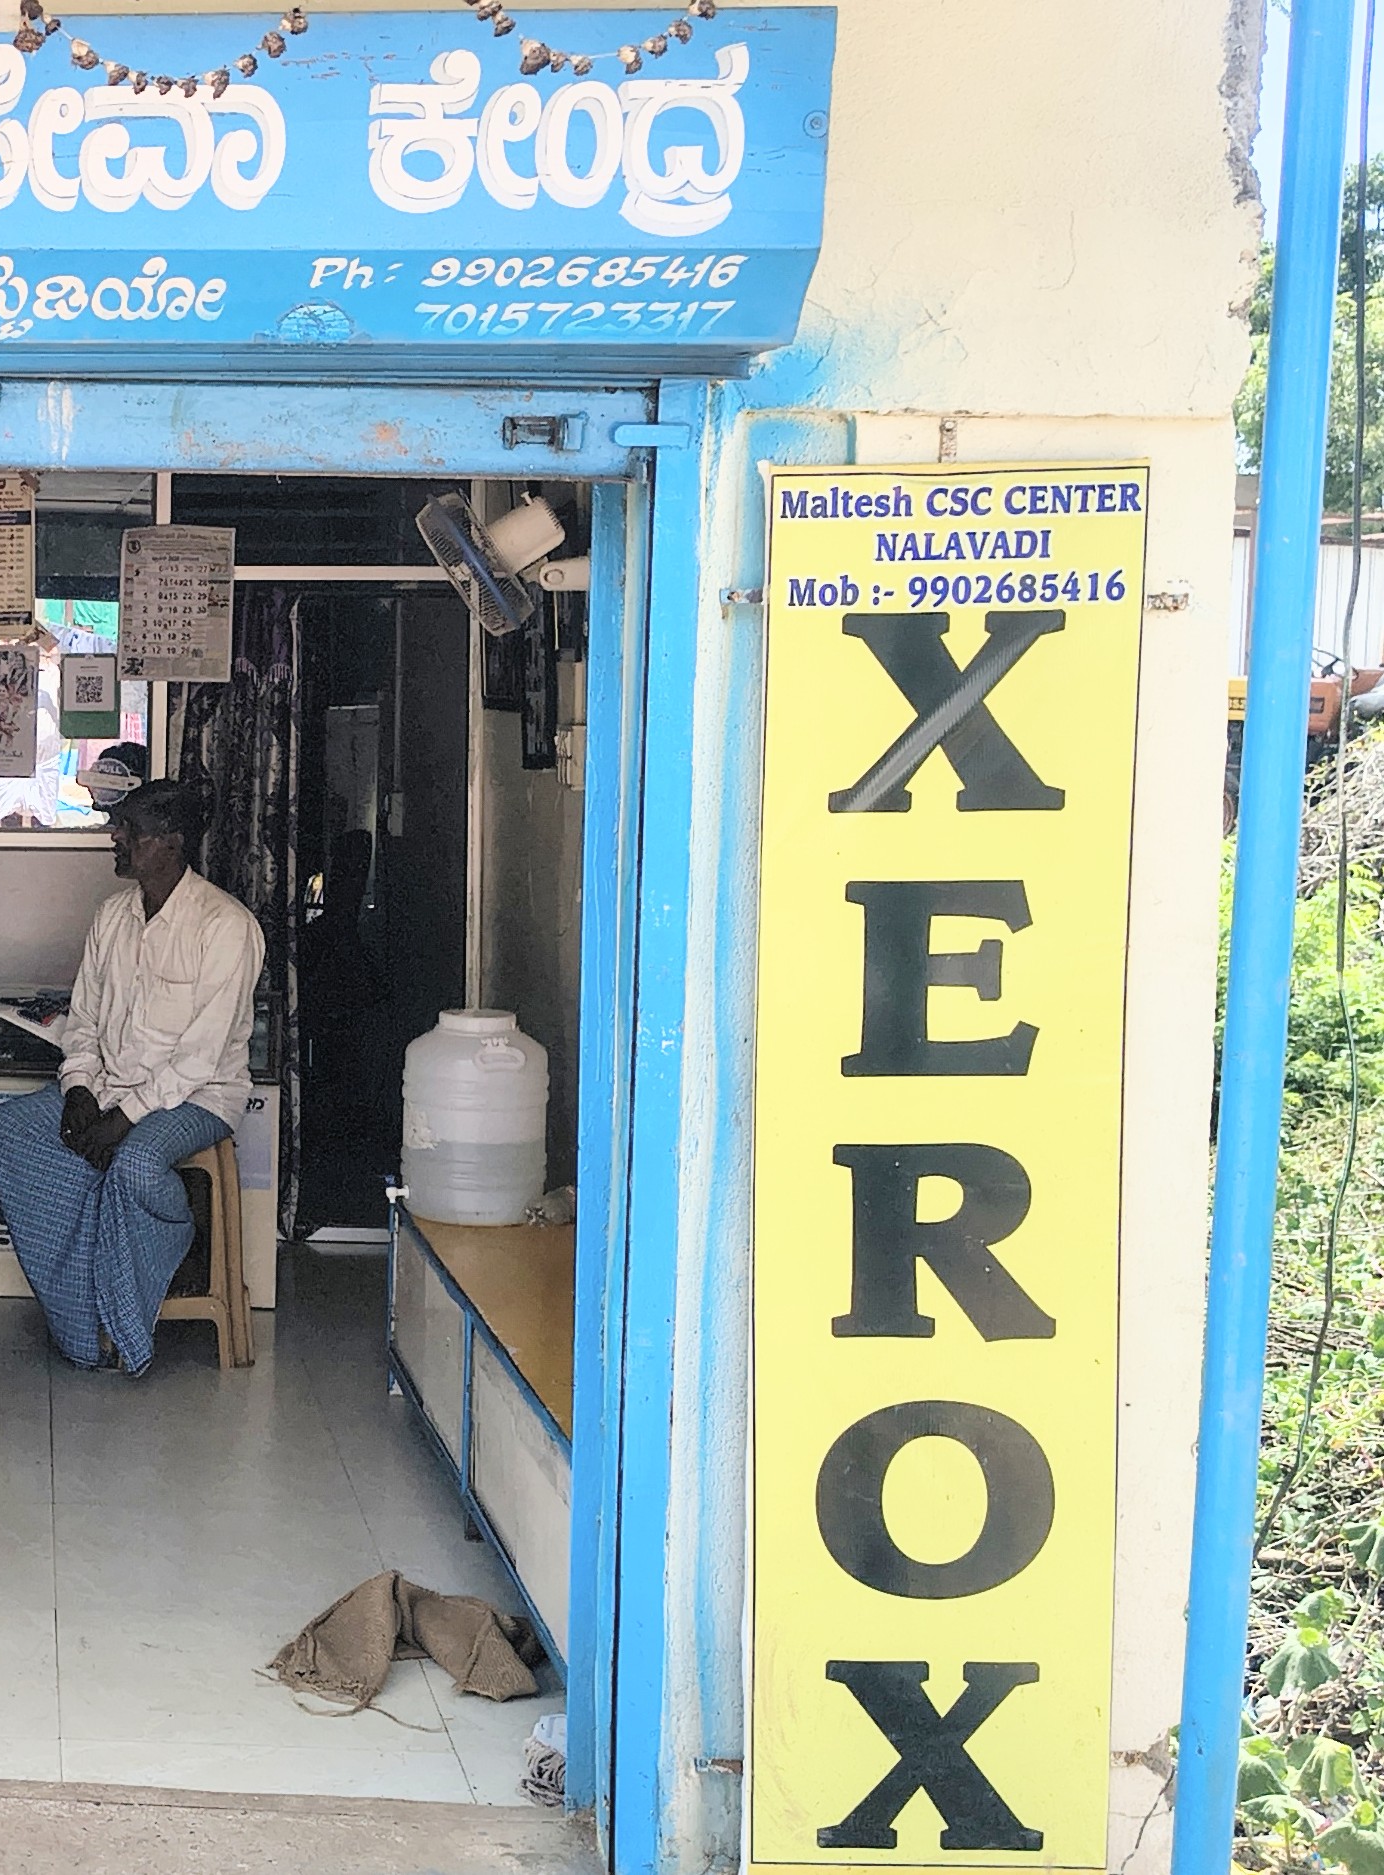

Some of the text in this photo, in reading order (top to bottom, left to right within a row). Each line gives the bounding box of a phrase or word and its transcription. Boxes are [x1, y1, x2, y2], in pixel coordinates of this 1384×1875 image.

[368, 42, 749, 238] ಕೇಂದ್ರ
[422, 255, 749, 289] 9902685416
[414, 302, 736, 336] 7015723317
[781, 483, 1141, 520] Maltesh CSC CENTER
[874, 529, 1051, 561] NALAVADI
[788, 576, 859, 607] Mob
[908, 571, 1126, 607] 9902685416
